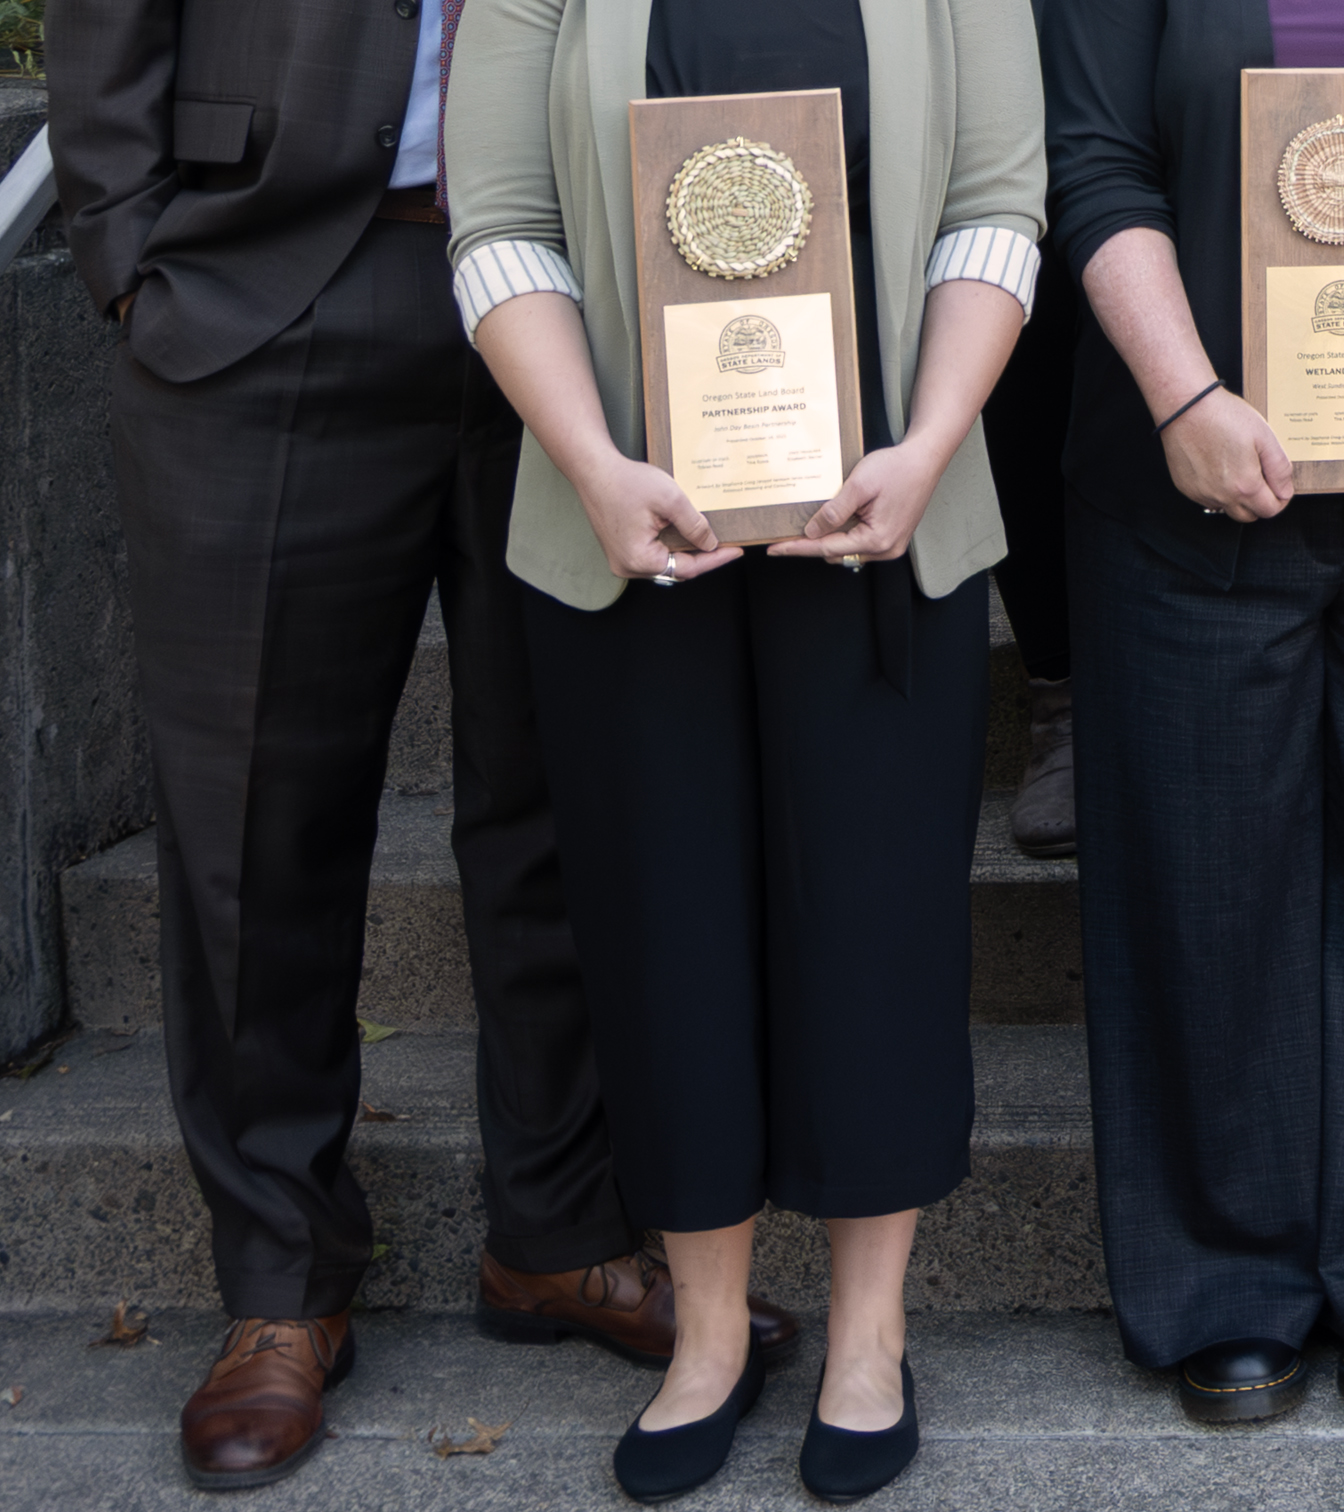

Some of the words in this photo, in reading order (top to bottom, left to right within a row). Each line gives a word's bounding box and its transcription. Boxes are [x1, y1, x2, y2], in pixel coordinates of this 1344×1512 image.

[722, 359, 748, 368] STATE
[702, 393, 732, 402] Oregon
[735, 392, 756, 400] State
[758, 390, 778, 398] Land
[780, 386, 804, 395] Board
[702, 406, 769, 418] PARTNERSHIP
[772, 403, 806, 412] AWARD
